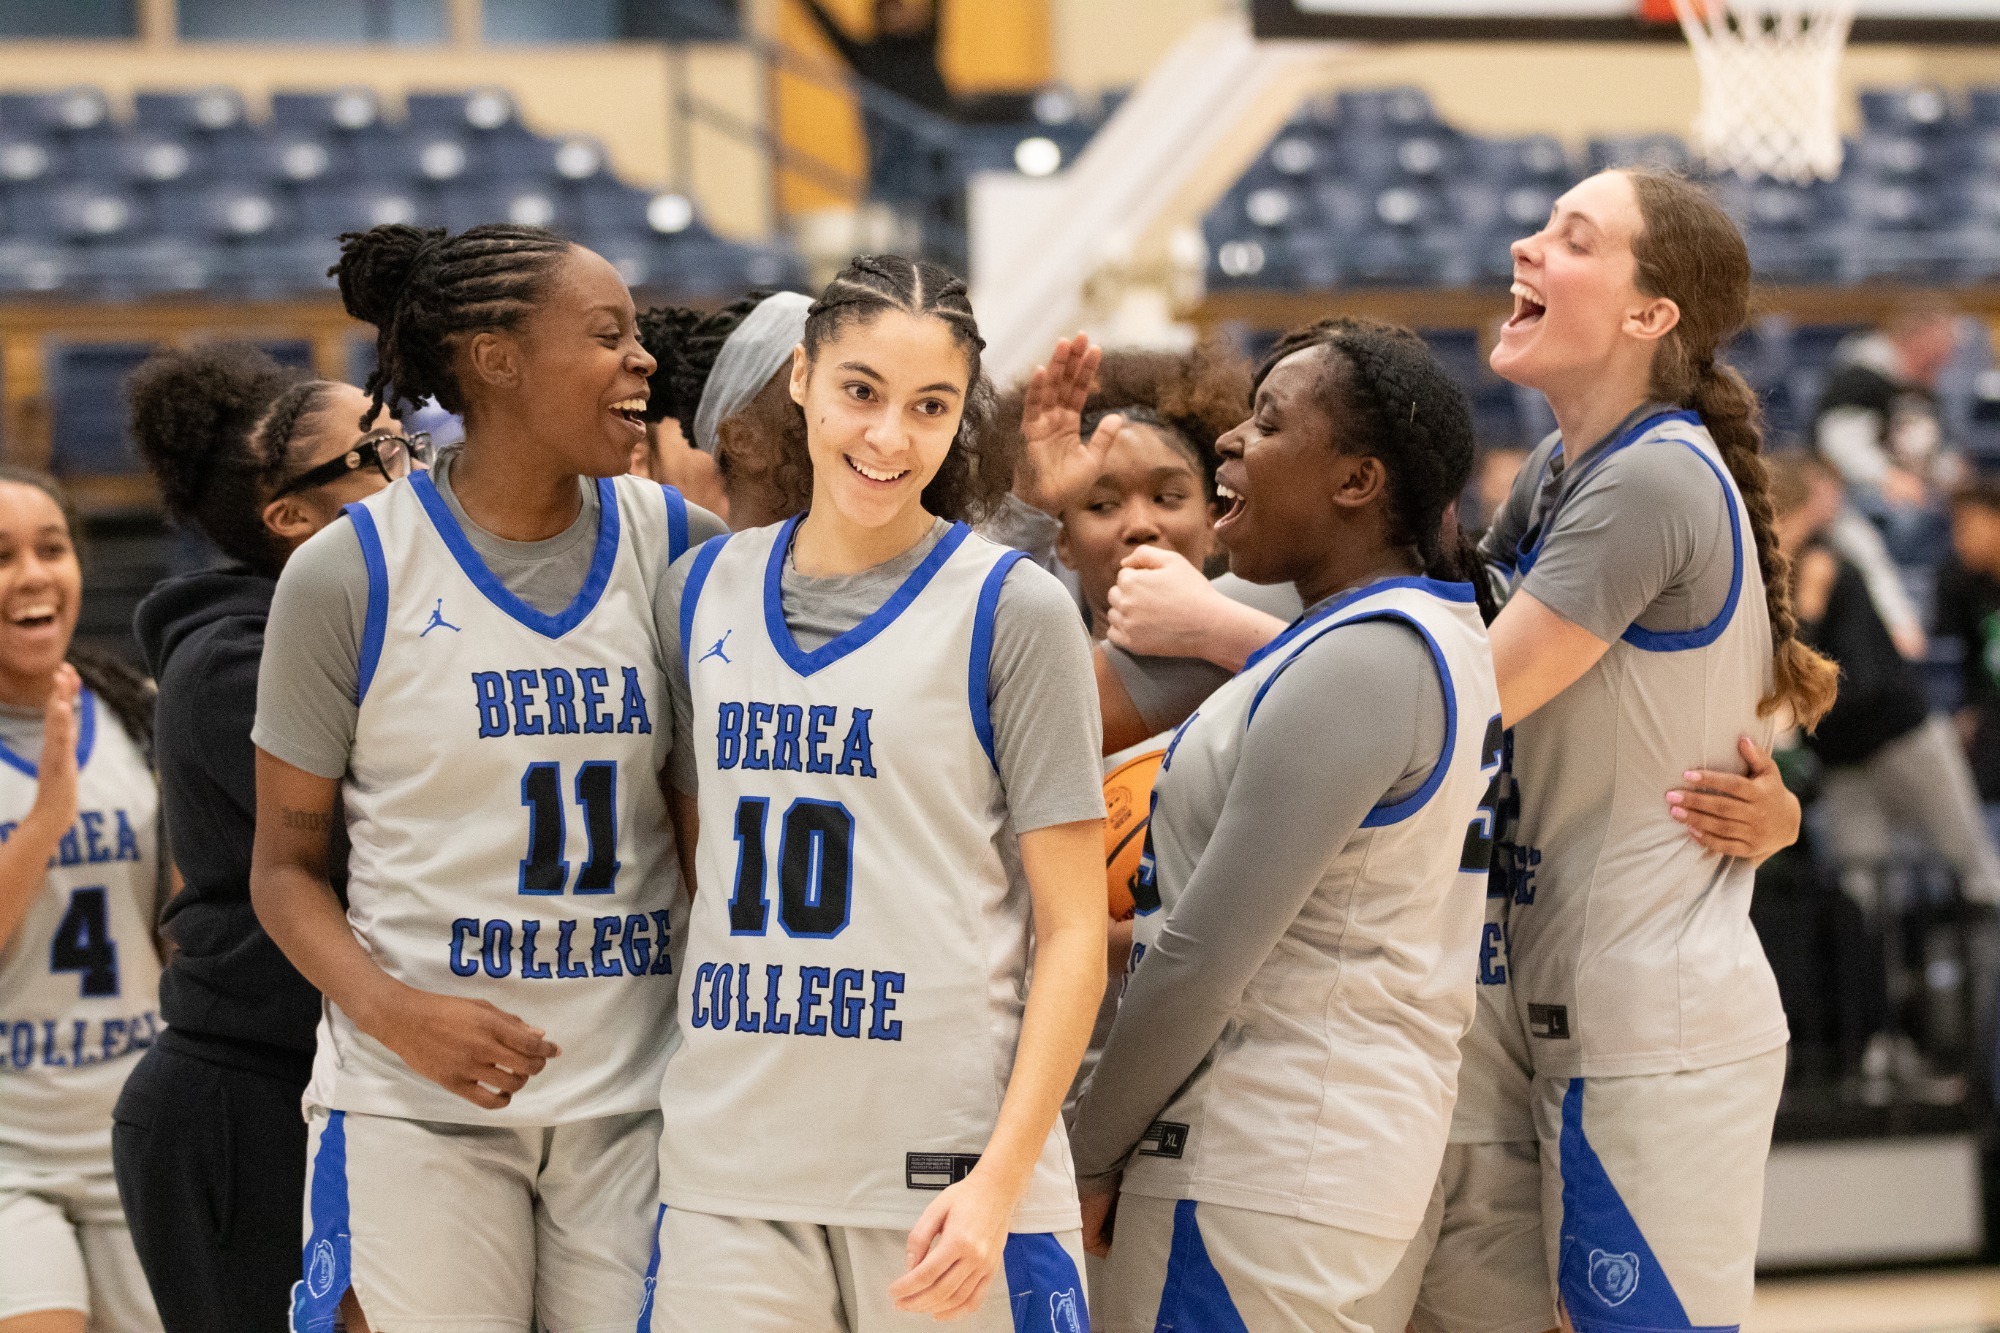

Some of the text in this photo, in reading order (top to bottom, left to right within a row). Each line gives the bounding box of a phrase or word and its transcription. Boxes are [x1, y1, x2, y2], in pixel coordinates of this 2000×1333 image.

[471, 666, 652, 738] BEREA
[716, 701, 877, 778] BEREA
[517, 760, 621, 895] 11
[727, 796, 855, 939] 10
[50, 885, 121, 999] 4
[448, 909, 673, 979] COLLEGE
[692, 961, 906, 1042] COLLEGE
[1164, 1132, 1178, 1147] XL
